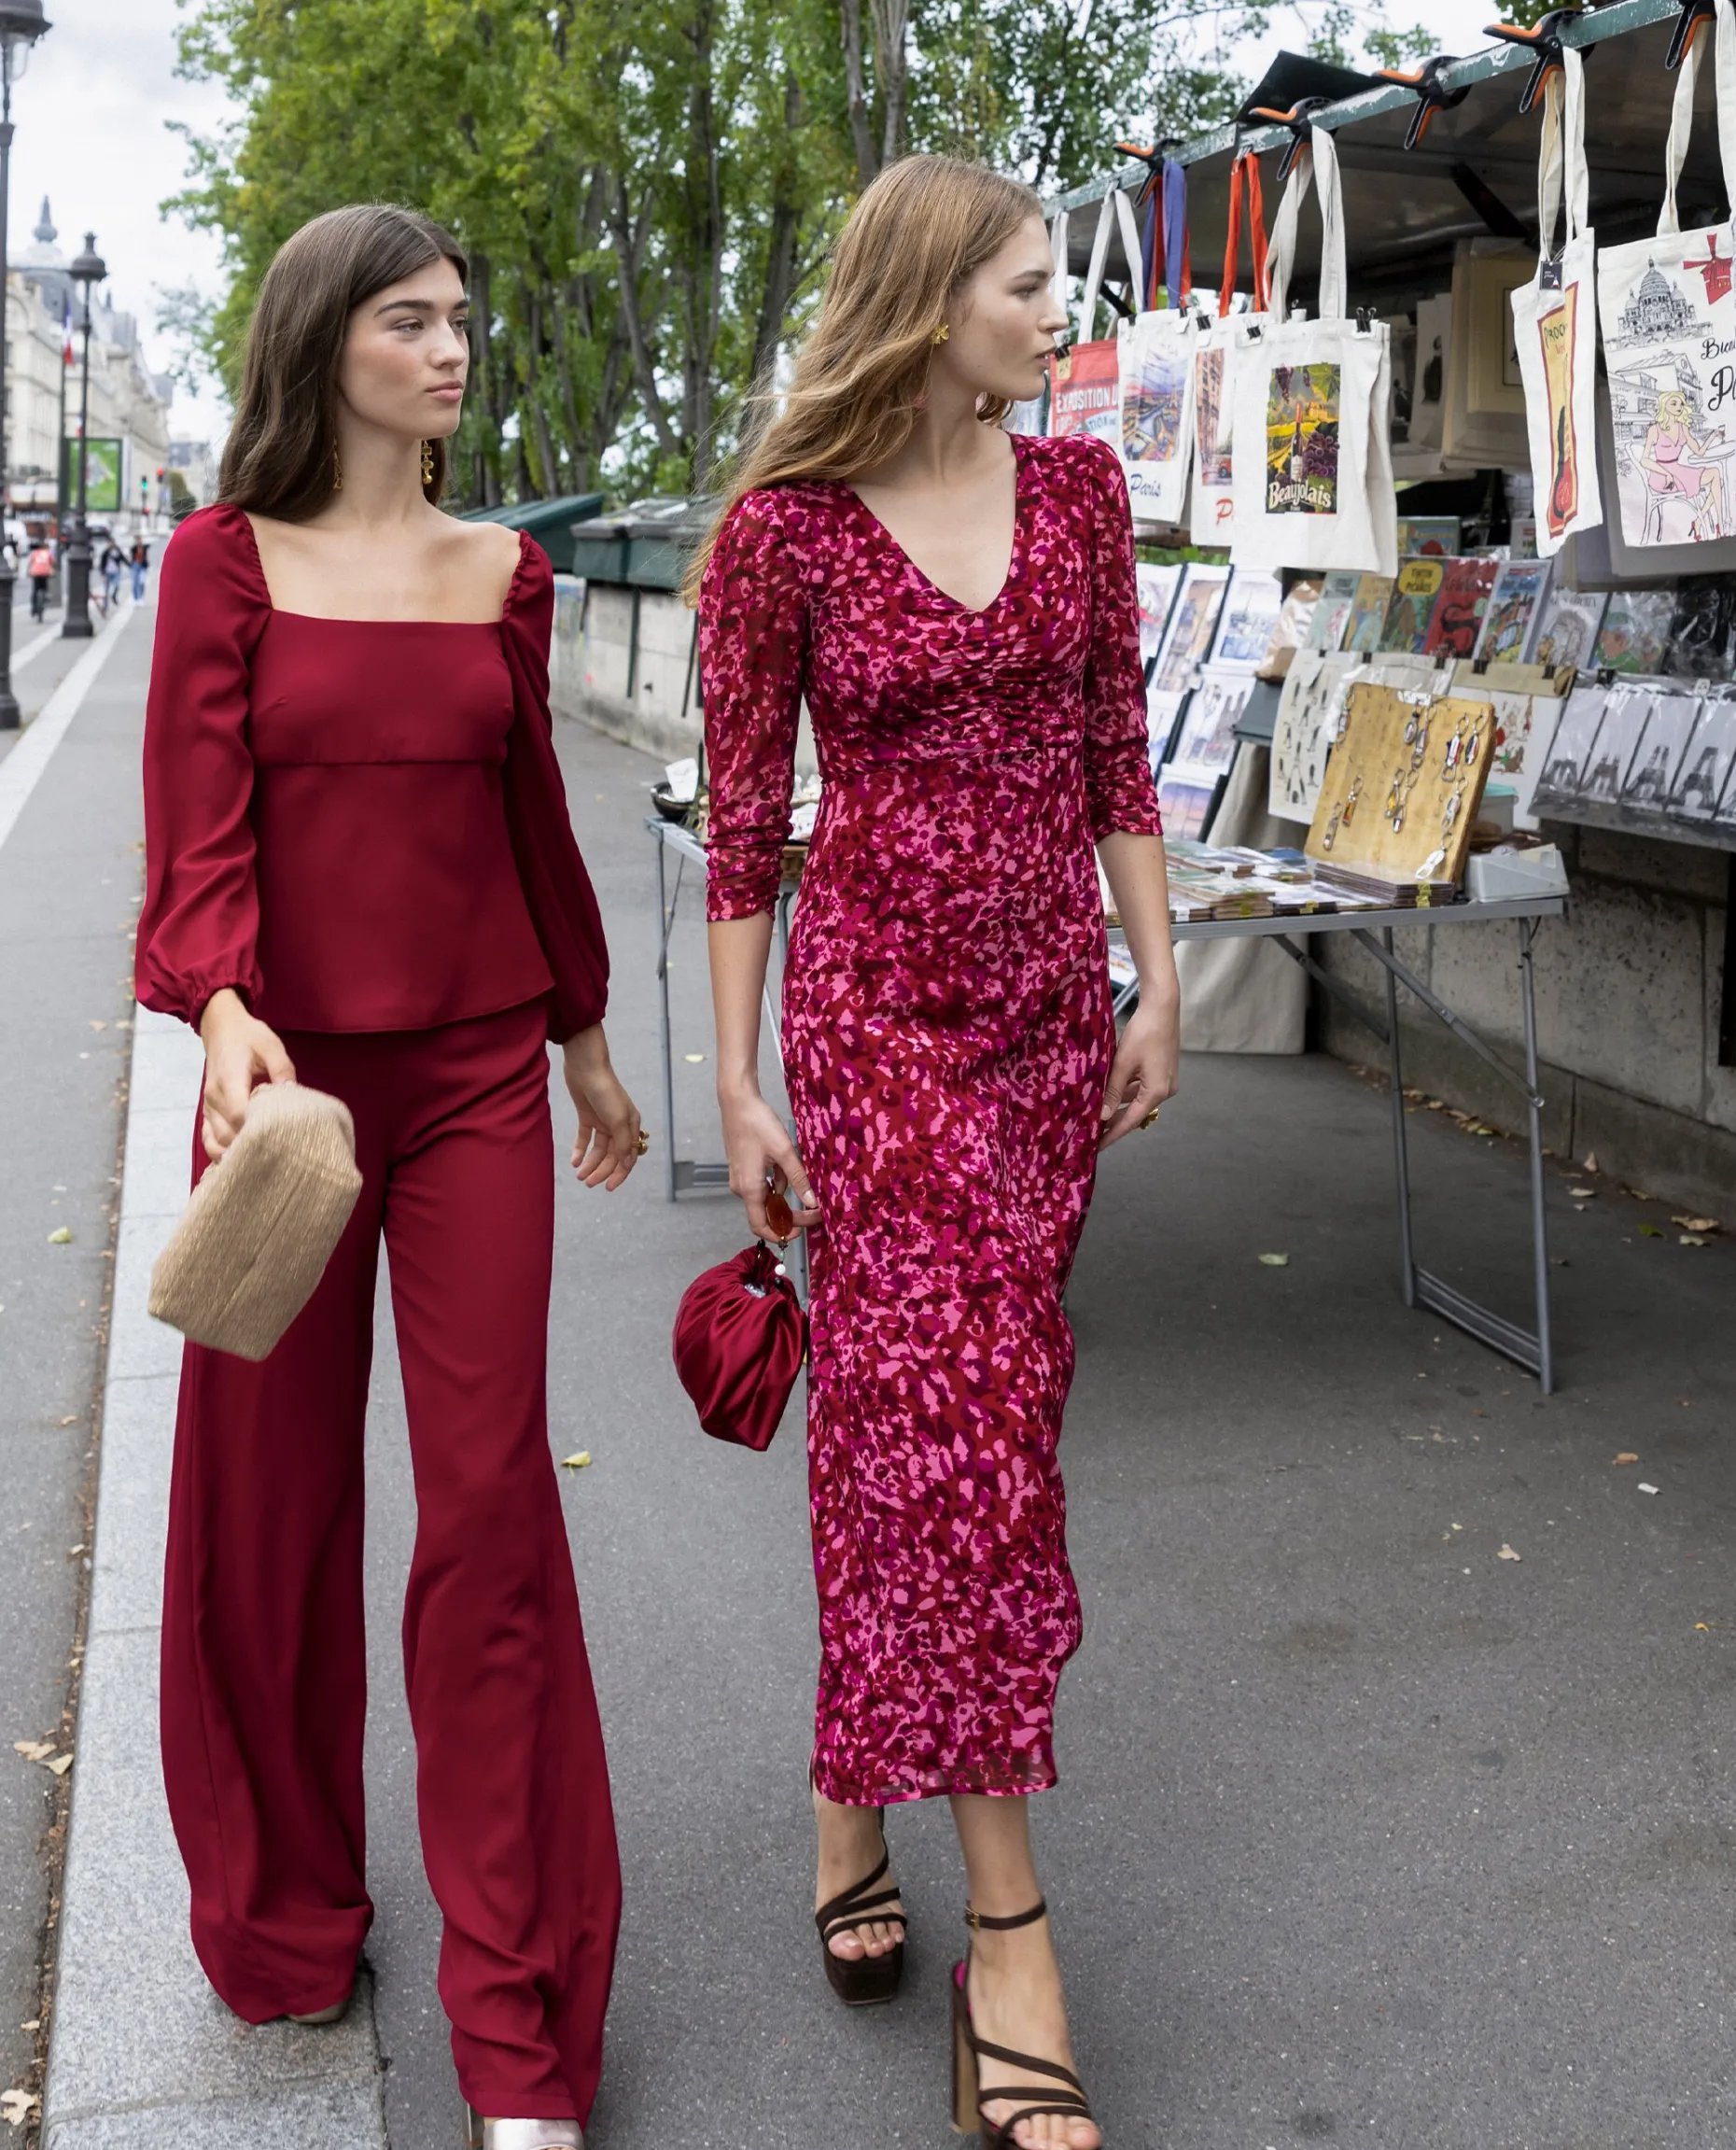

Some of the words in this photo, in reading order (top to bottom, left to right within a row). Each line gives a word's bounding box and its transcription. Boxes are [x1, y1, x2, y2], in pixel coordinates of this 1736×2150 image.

[1056, 386, 1111, 415] EXPOSITION
[1129, 472, 1162, 498] Paris
[1268, 479, 1332, 510] Beaujolais
